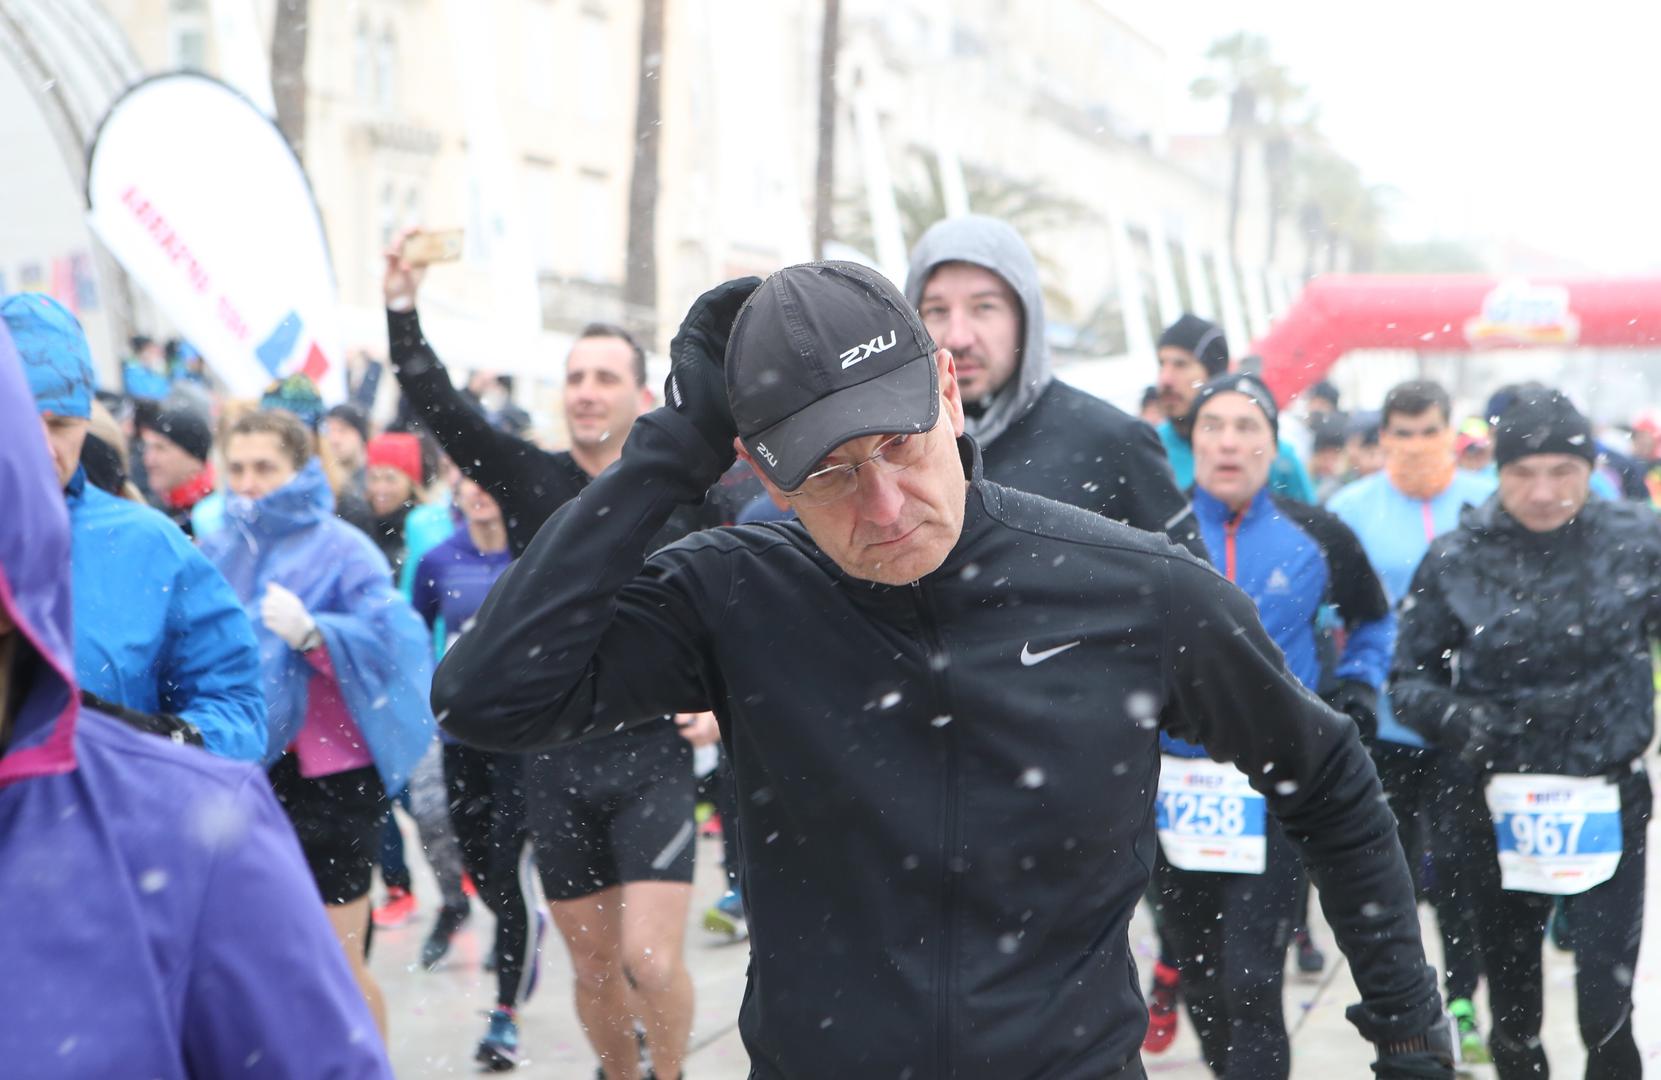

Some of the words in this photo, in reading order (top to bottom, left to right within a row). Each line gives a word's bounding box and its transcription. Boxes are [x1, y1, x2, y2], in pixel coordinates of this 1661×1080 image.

[839, 329, 897, 370] 2XU
[756, 441, 778, 468] 2XU
[1163, 794, 1245, 836] 1258
[1510, 813, 1588, 857] 967
